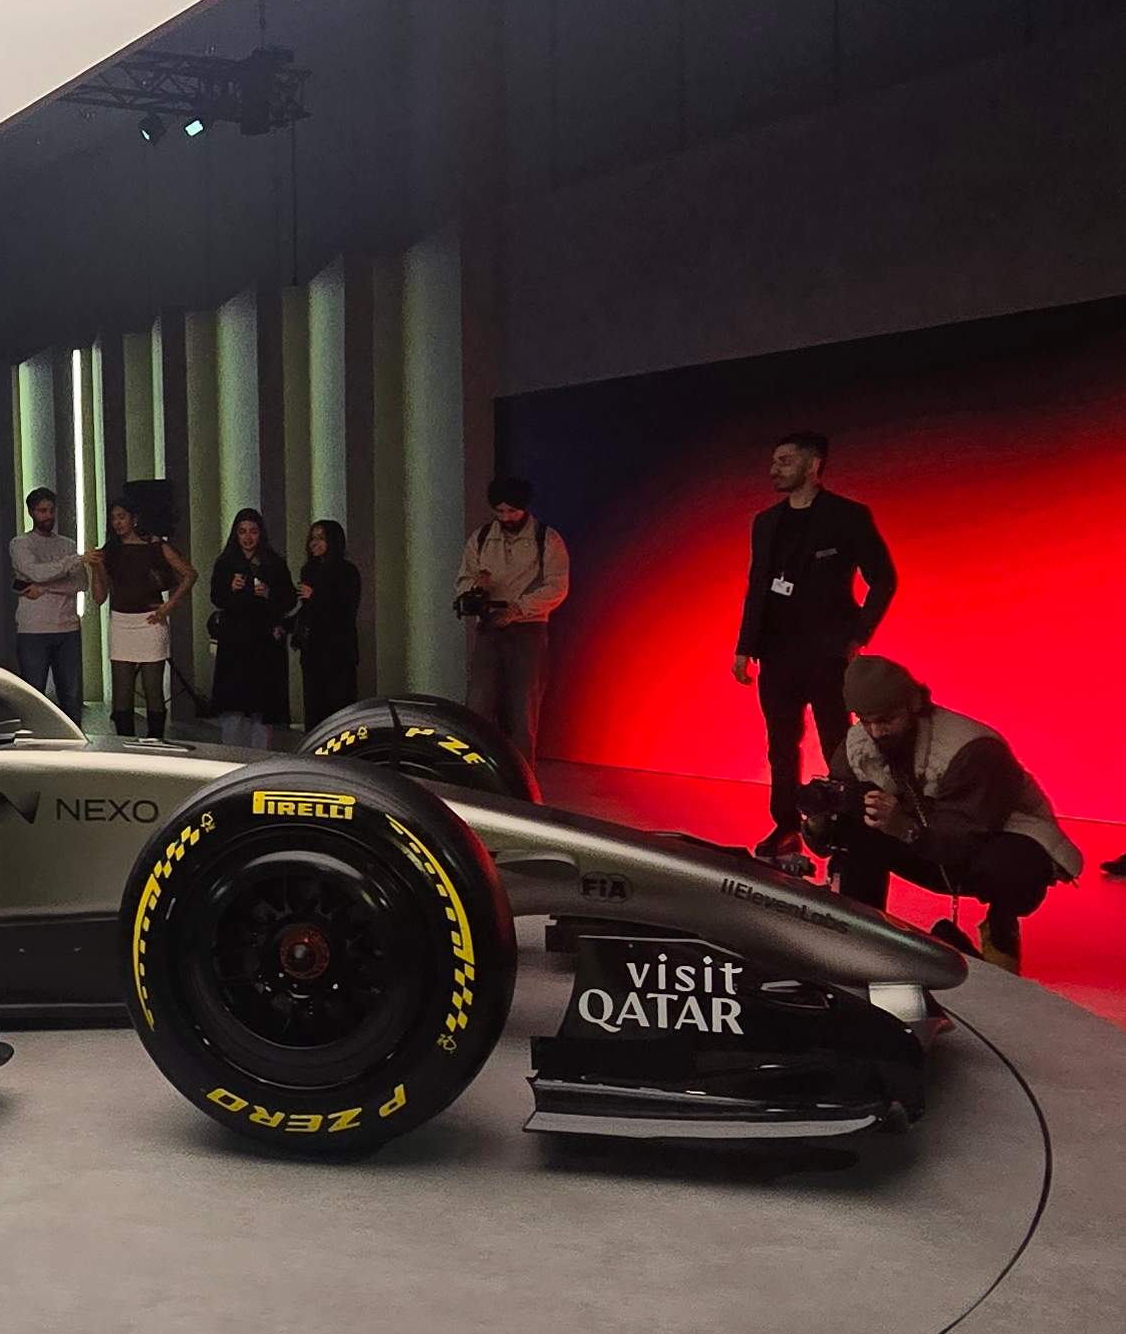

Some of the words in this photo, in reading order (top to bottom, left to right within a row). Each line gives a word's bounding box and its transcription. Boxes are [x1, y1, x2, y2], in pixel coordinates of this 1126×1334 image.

[437, 735, 486, 764] ZE
[56, 798, 159, 824] NEXO
[253, 791, 356, 820] PIRELLI
[626, 953, 743, 995] visit
[578, 988, 744, 1035] QATAR
[206, 1088, 363, 1133] ZERO
[379, 1084, 407, 1117] P
